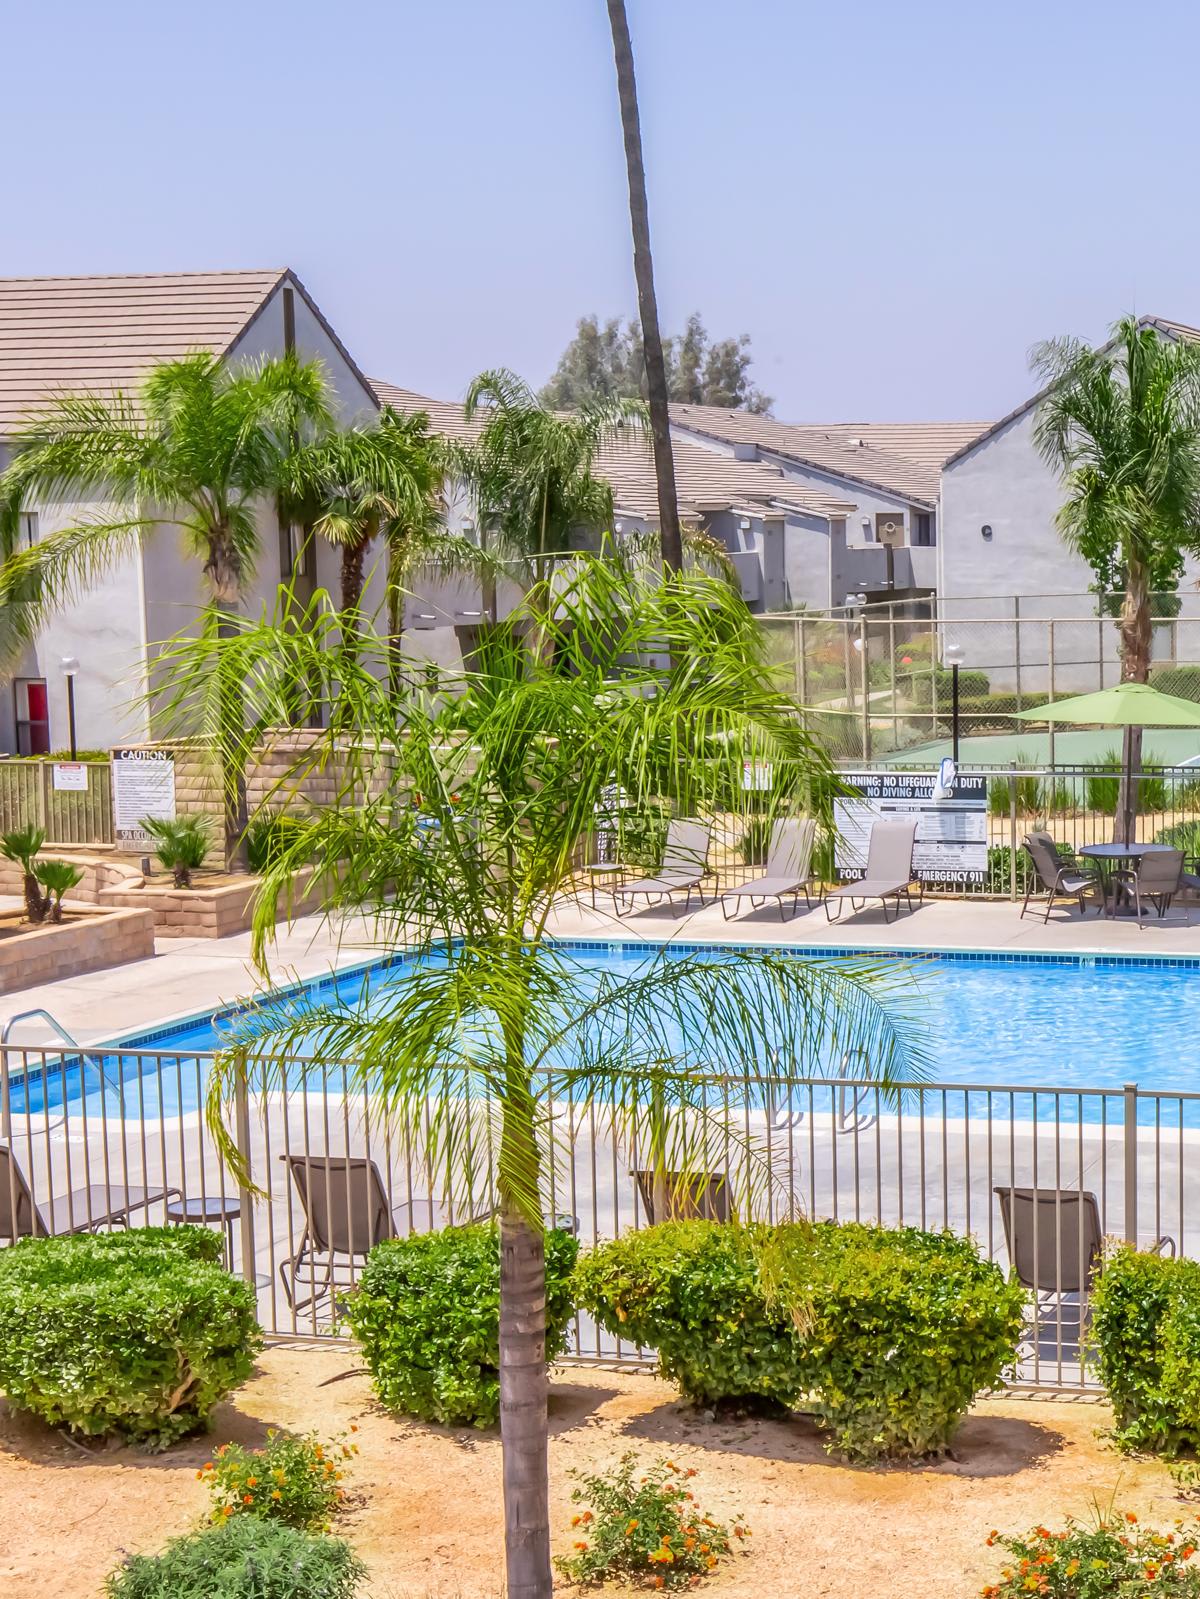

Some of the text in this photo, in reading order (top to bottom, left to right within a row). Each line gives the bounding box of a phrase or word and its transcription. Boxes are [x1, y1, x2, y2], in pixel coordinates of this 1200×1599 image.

[121, 750, 167, 760] CAUTION
[884, 776, 896, 787] NO
[898, 777, 937, 787] LIFEGUAR
[961, 778, 983, 788] DUTY
[867, 787, 953, 798] NO DIVING ALLOD
[122, 830, 133, 840] SPA
[840, 868, 863, 879] POOL
[918, 870, 968, 882] EMERGENCY
[970, 871, 983, 882] 911
